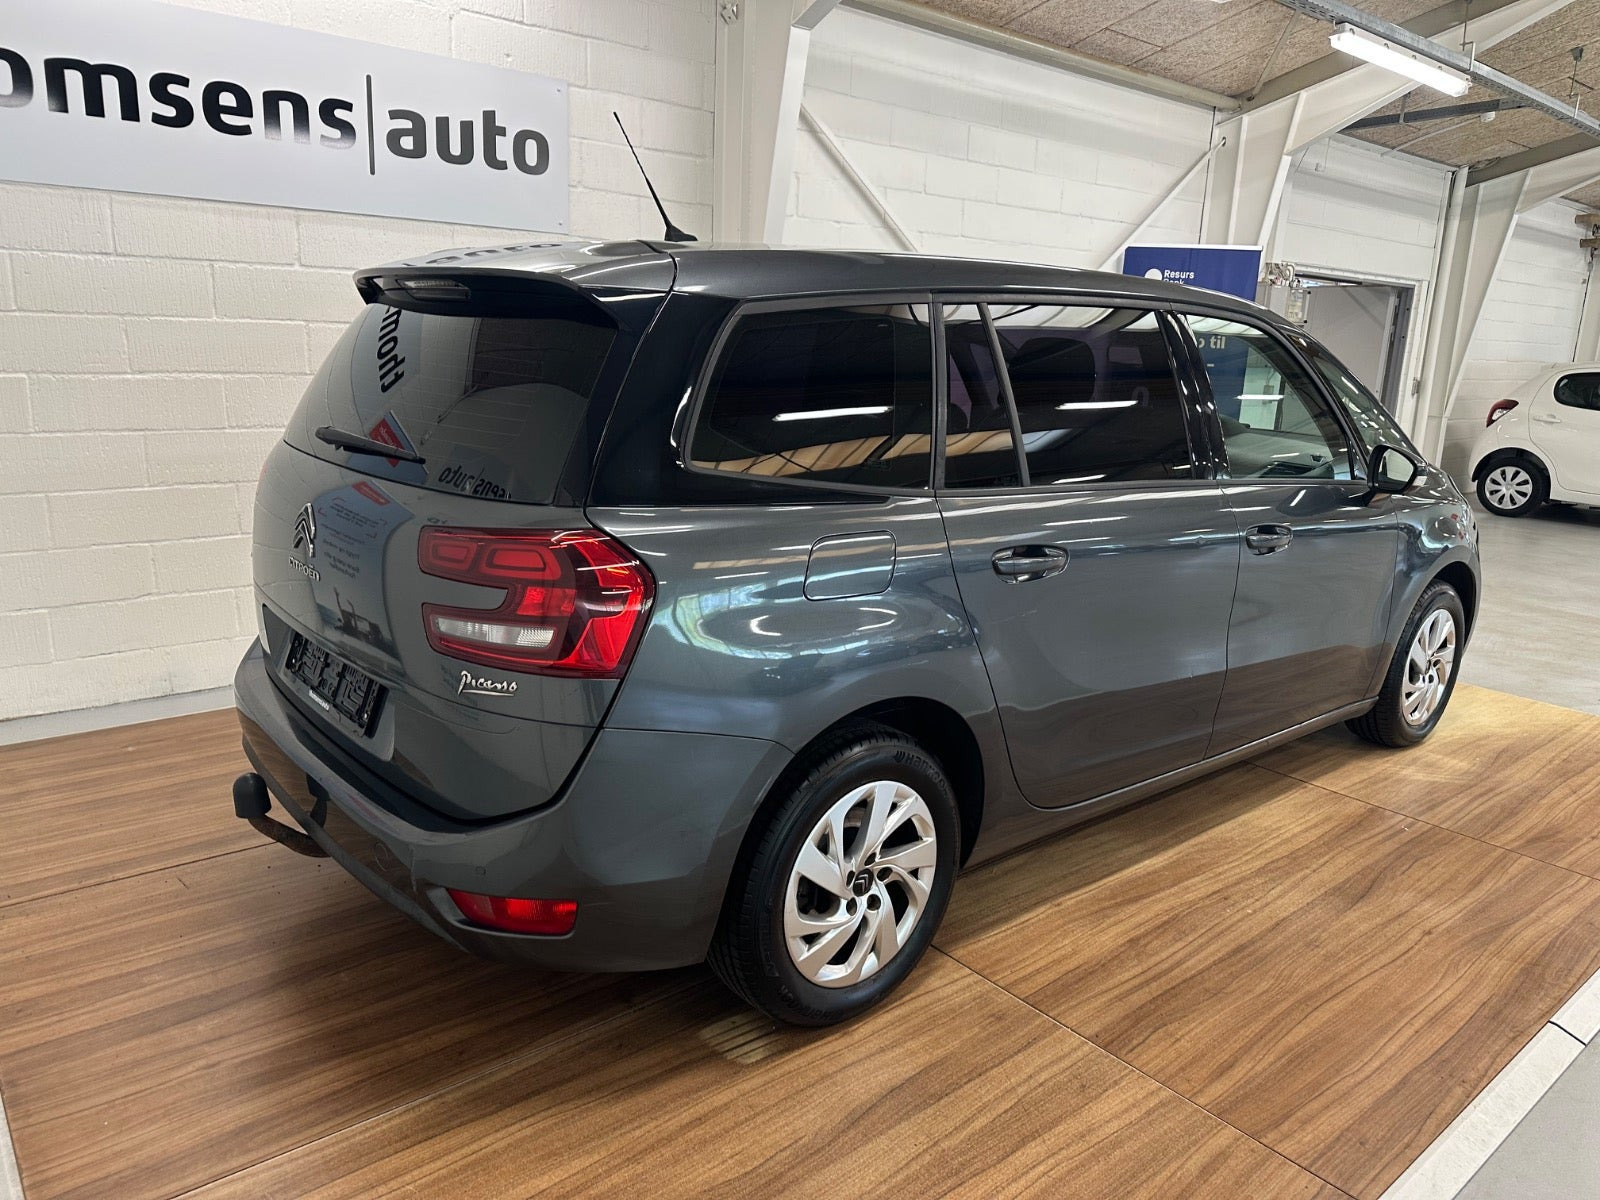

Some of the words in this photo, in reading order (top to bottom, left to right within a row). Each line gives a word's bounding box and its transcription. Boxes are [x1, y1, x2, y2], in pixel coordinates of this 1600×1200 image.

[386, 108, 550, 176] auto
[1164, 269, 1195, 279] Resurs
[1209, 335, 1226, 349] til
